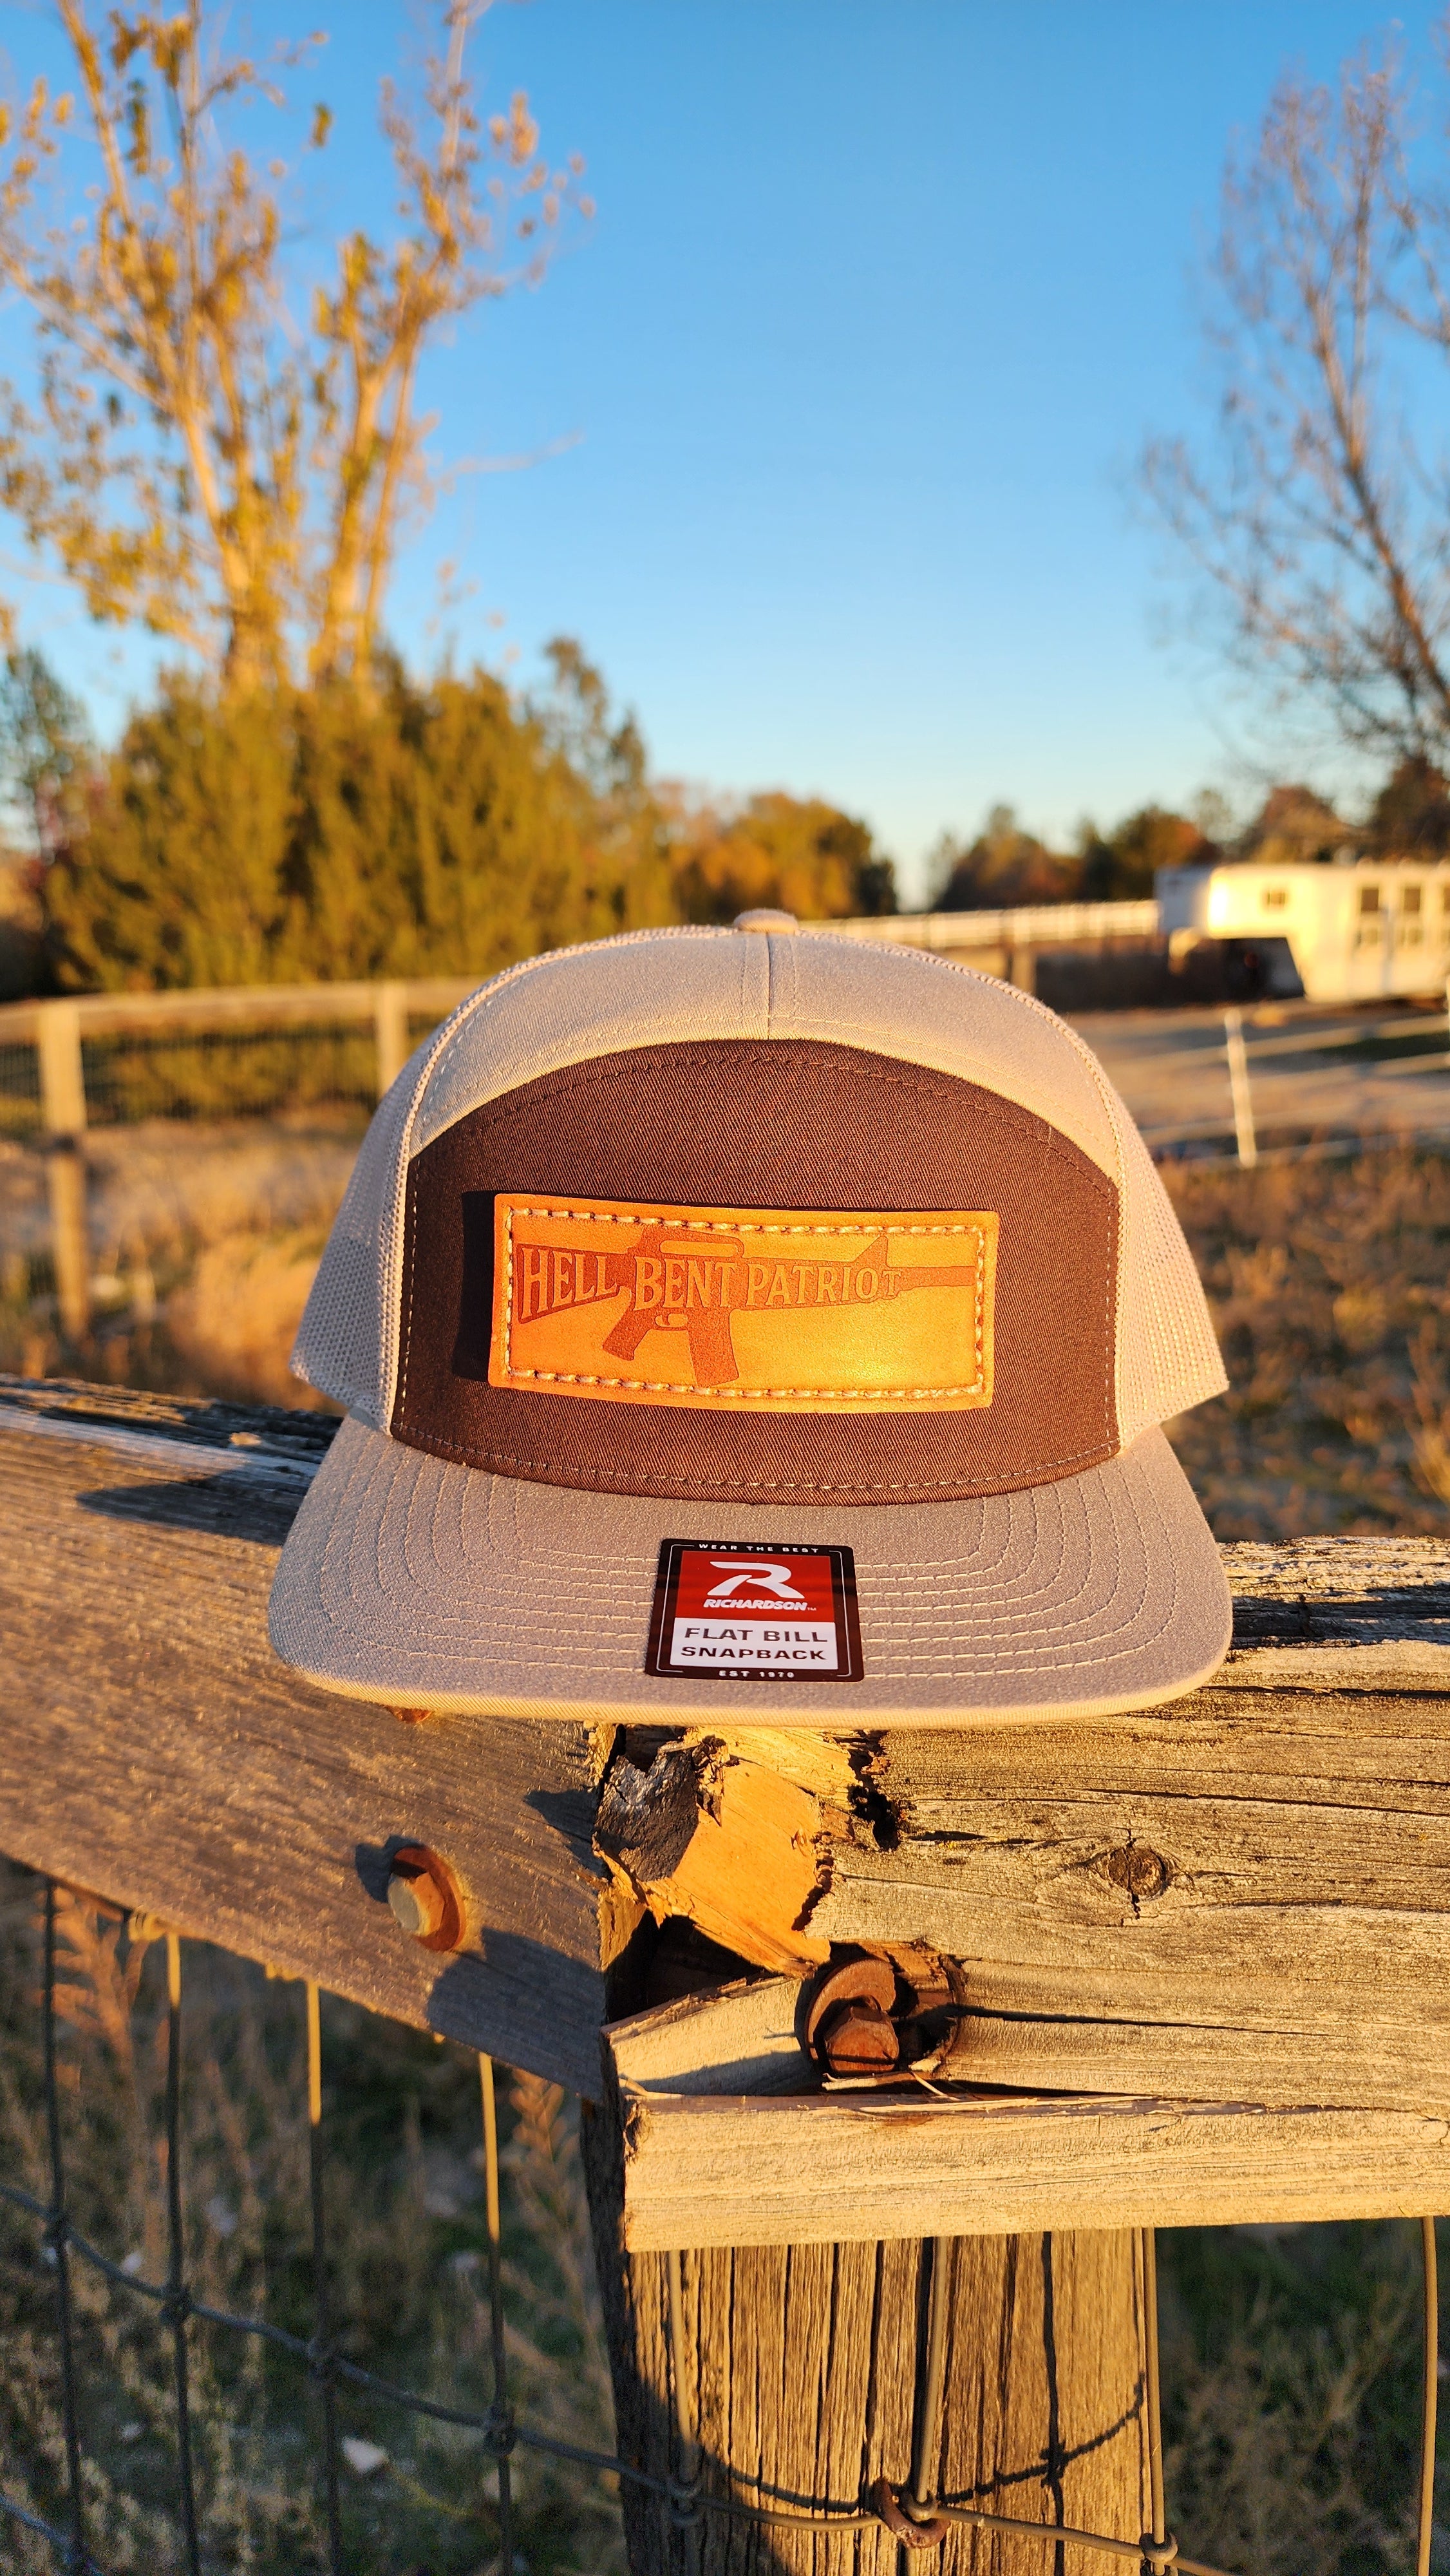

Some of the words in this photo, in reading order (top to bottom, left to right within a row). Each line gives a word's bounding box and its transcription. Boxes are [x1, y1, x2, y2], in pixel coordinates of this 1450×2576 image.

[520, 1247, 618, 1320] HELL
[632, 1256, 737, 1311] BENT
[745, 1263, 903, 1306] PATRIOT
[703, 1598, 808, 1611] RICHARDSON
[684, 1627, 753, 1641] FLAT
[763, 1630, 828, 1643] BILL
[680, 1646, 827, 1660] SNAPBACK
